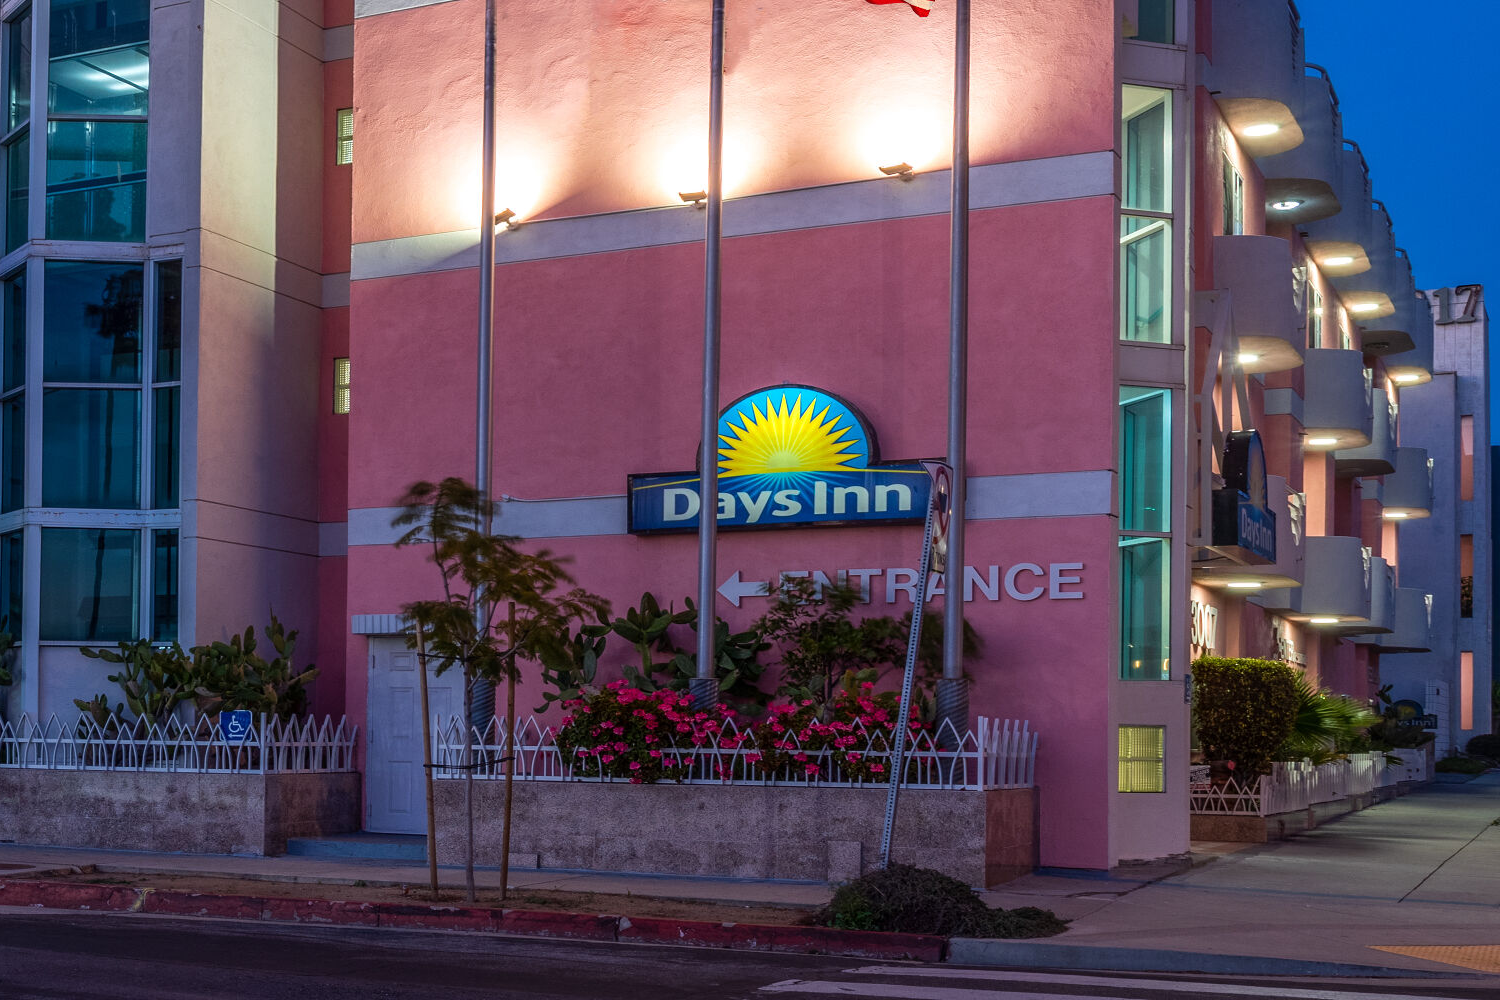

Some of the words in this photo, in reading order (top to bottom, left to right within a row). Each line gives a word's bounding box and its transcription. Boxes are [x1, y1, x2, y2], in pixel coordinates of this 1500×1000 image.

[1433, 284, 1481, 325] 17
[663, 488, 802, 523] Days
[814, 481, 912, 515] Inn
[1241, 507, 1260, 549] Days
[1260, 519, 1272, 553] Inn
[1191, 600, 1218, 649] 3007
